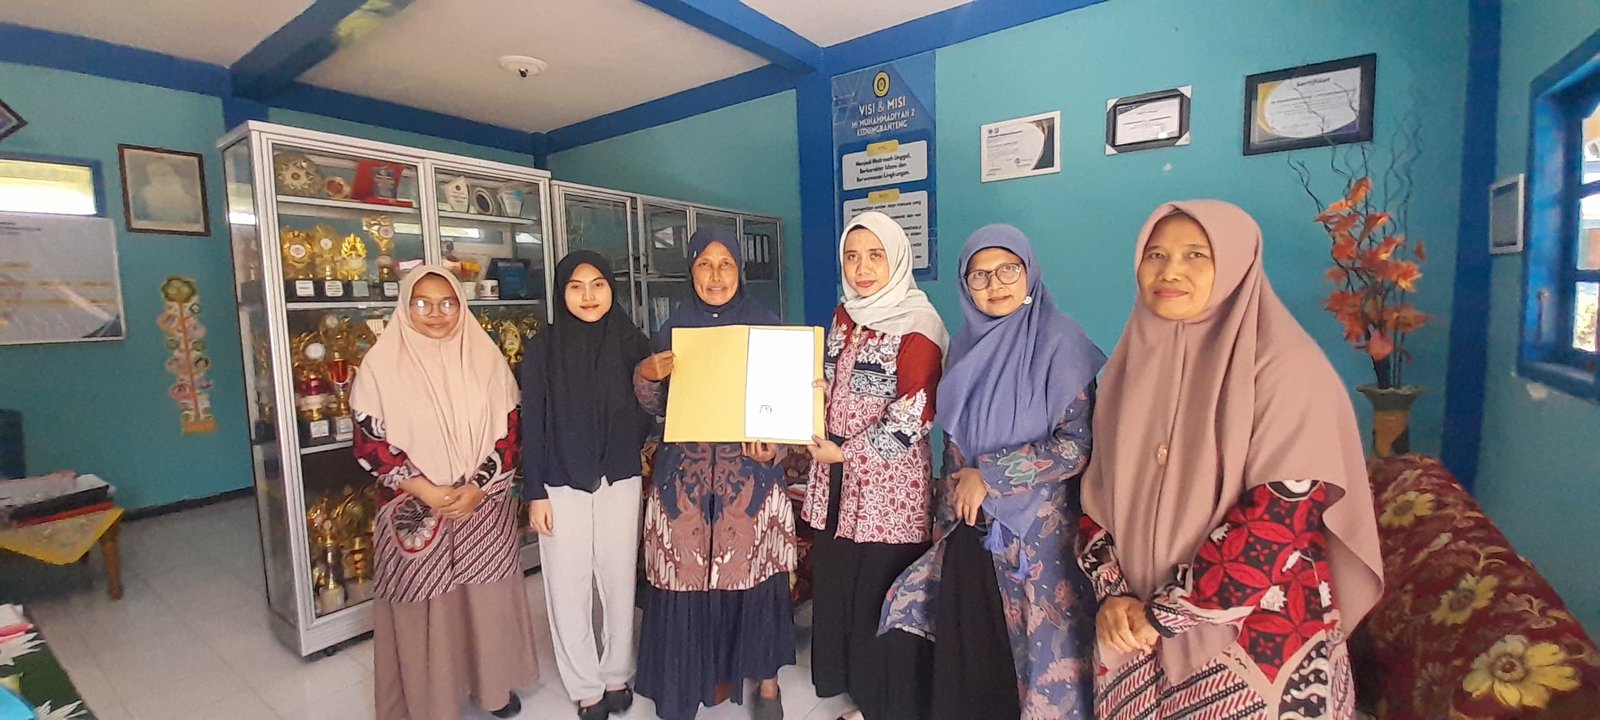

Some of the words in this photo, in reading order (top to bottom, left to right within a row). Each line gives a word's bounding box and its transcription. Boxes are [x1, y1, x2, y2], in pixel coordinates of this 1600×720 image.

[858, 103, 875, 116] VISI
[878, 100, 884, 113] &
[887, 96, 906, 110] MISI
[859, 109, 910, 127] MUHAMMADIYAH
[856, 120, 908, 136] KEDUNGBANTENG
